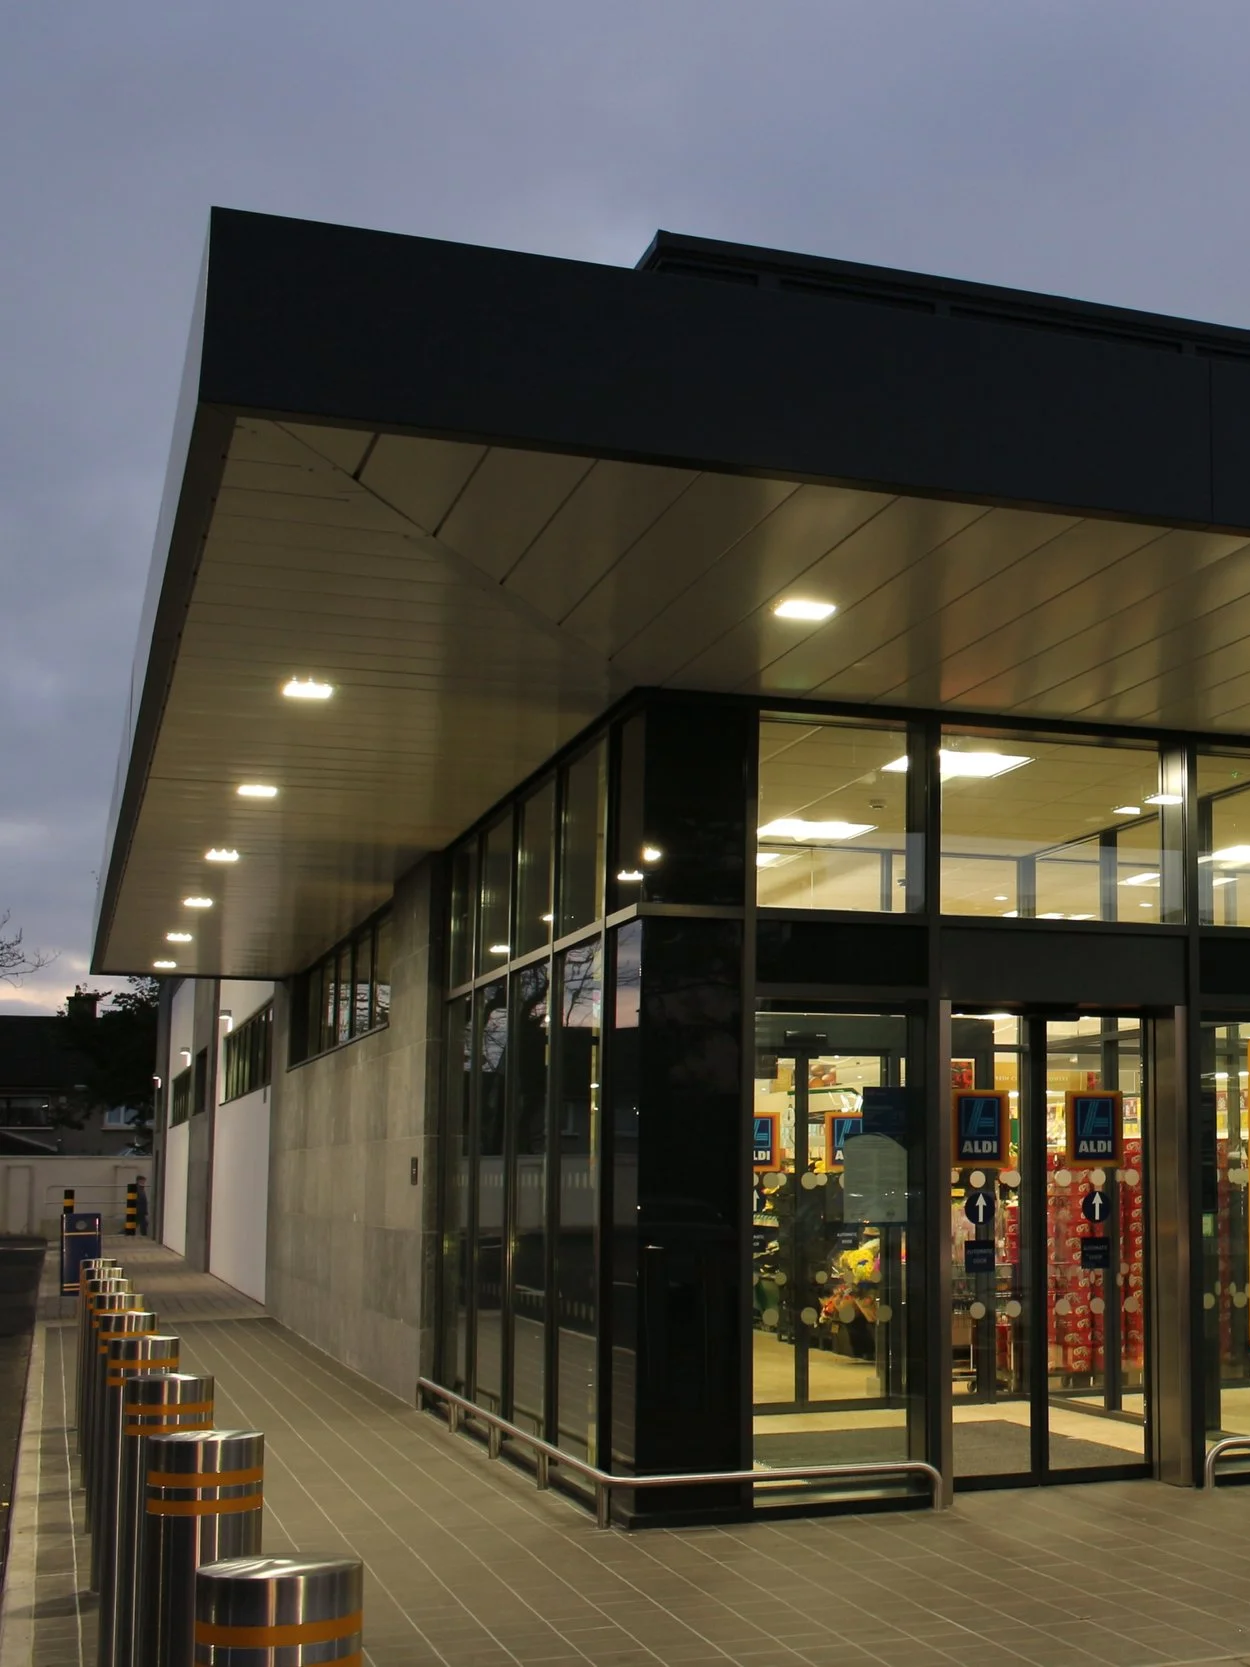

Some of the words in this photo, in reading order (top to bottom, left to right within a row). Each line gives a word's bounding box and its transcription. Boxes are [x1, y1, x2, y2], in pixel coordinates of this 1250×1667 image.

[962, 1140, 998, 1154] ALDI
[1079, 1140, 1112, 1153] ALDI
[753, 1150, 771, 1161] LDI
